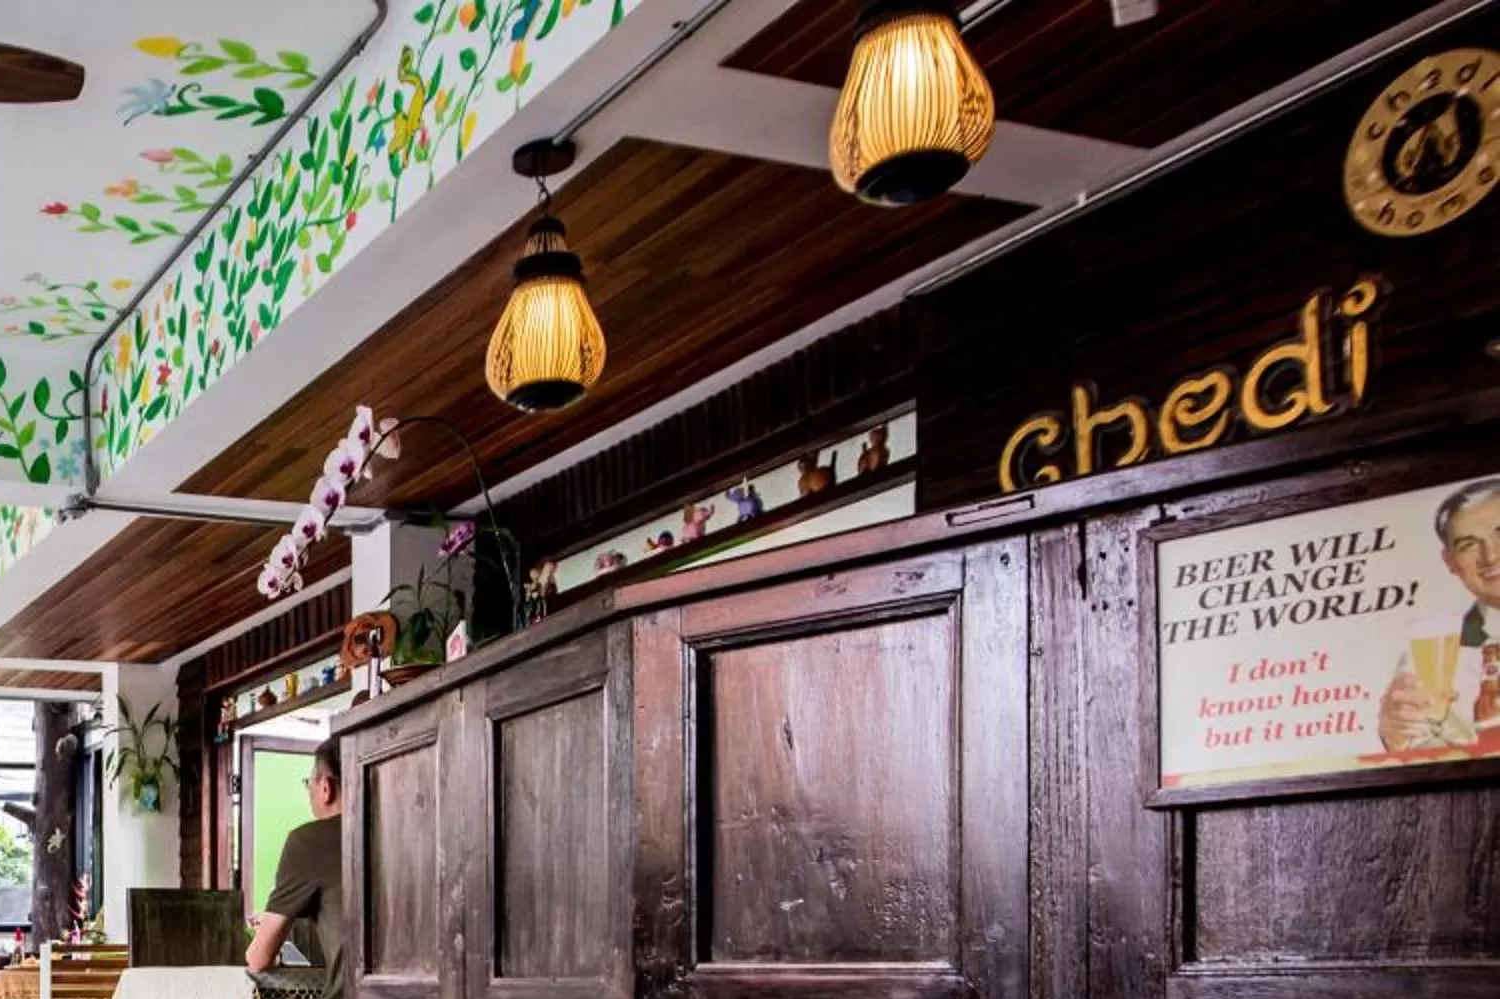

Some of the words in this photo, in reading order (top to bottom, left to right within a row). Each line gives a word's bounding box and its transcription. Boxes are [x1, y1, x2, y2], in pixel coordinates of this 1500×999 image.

[1173, 549, 1274, 589] BEER
[1289, 526, 1396, 568] WILL
[1198, 560, 1367, 610] CHANGE
[1163, 611, 1238, 646] THE
[1252, 581, 1420, 631] WORLD!
[1228, 662, 1241, 684] I
[1248, 651, 1331, 682] don't
[1198, 695, 1283, 719] know
[1204, 725, 1252, 749] but
[1263, 719, 1284, 741] it
[1294, 711, 1364, 738] will.
